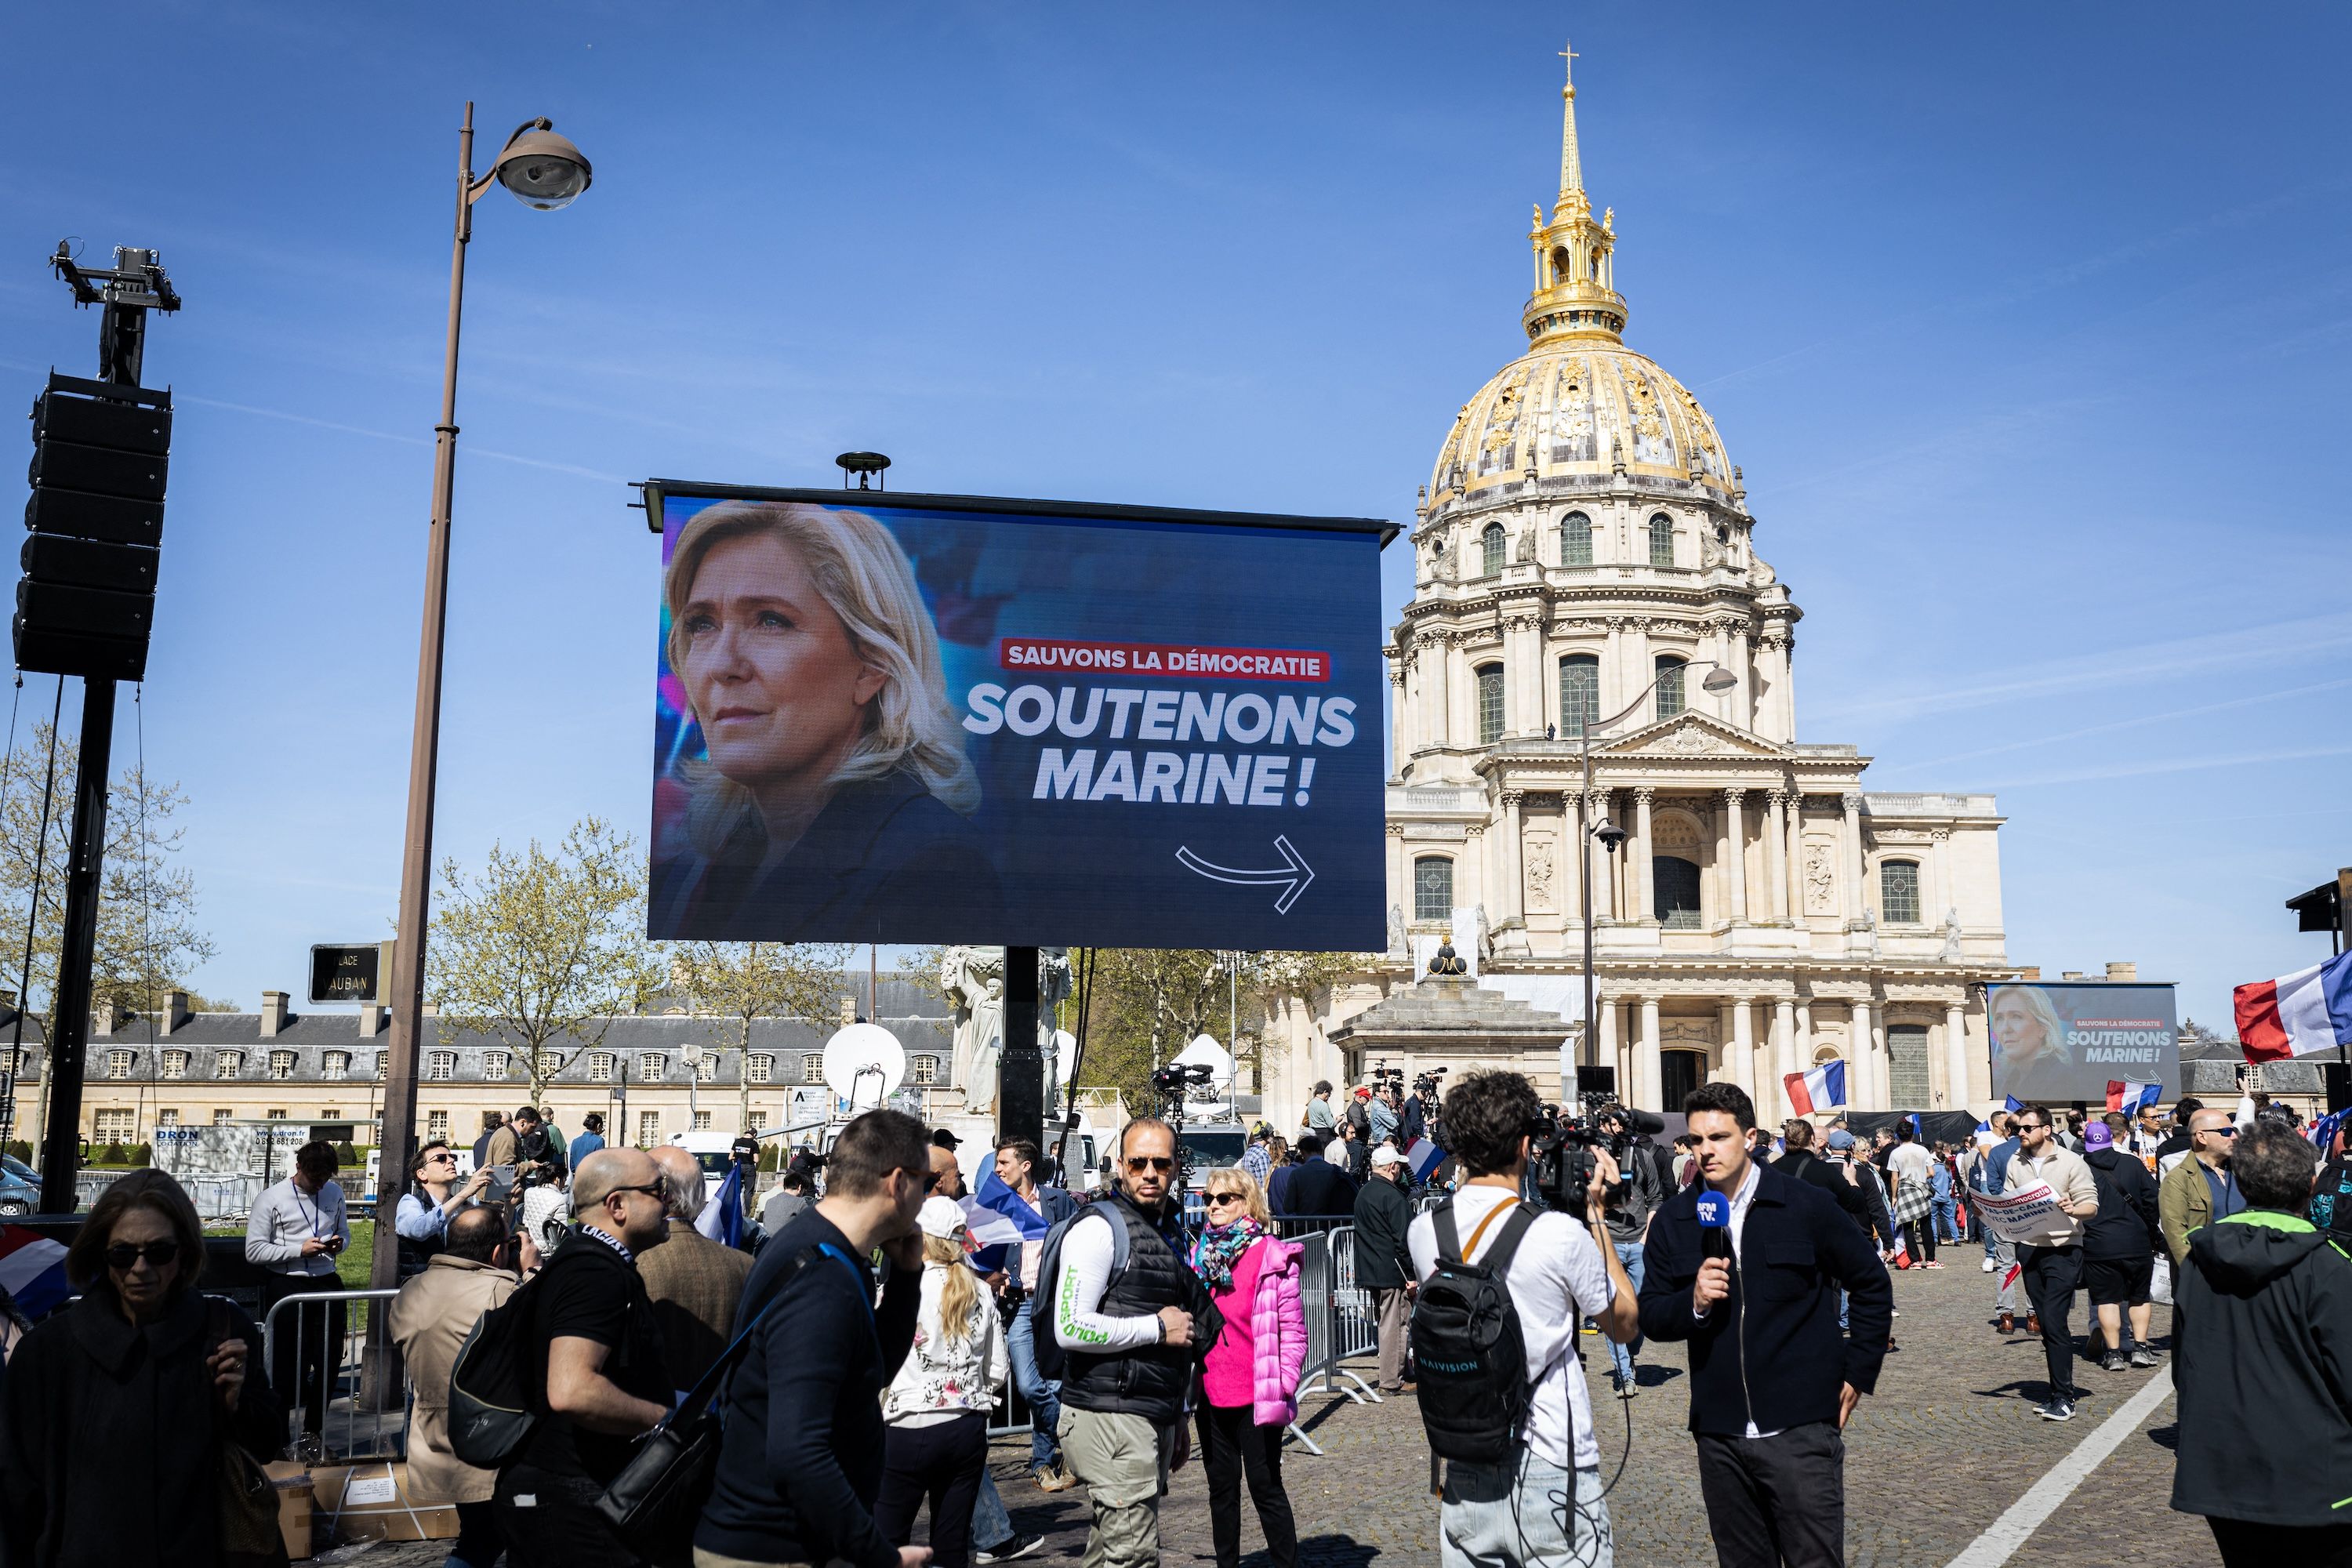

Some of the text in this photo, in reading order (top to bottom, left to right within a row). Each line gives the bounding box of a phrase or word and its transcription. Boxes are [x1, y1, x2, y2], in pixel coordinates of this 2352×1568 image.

[1008, 645, 1321, 677] SAUVONS LA DÉMOCRATIE
[961, 683, 1357, 747] SOUTENONS
[2067, 1031, 2171, 1046] SOUTENONS
[2007, 1209, 2046, 1222] MARINE
[1060, 1265, 1109, 1345] POLO SPORT
[1420, 1357, 1478, 1373] HAIVISION
